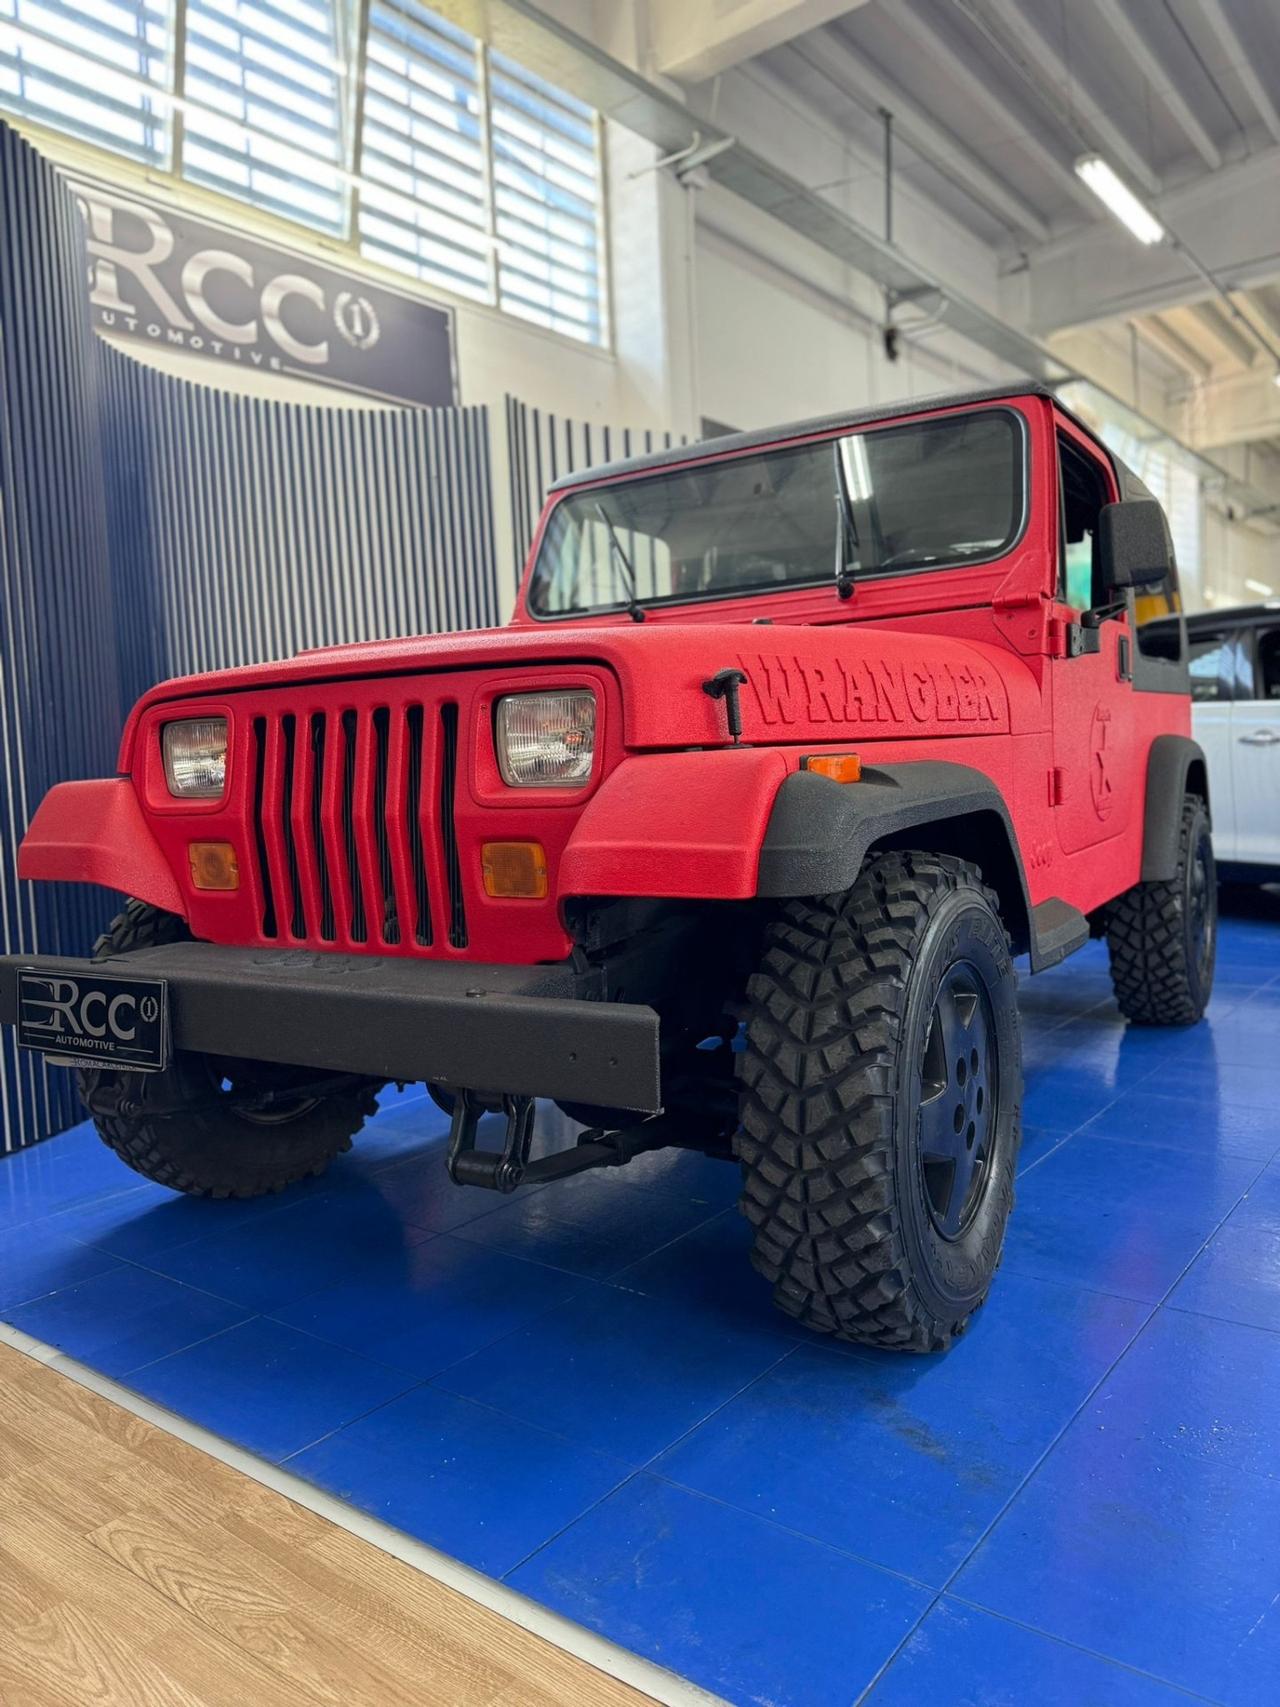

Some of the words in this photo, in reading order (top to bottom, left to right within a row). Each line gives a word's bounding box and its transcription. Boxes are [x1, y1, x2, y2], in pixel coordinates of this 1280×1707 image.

[101, 311, 284, 371] UTOMOTIVE
[736, 653, 1000, 726] WRANGLER
[22, 976, 136, 1041] RCC
[55, 1034, 116, 1051] AUTOMOTIVE
